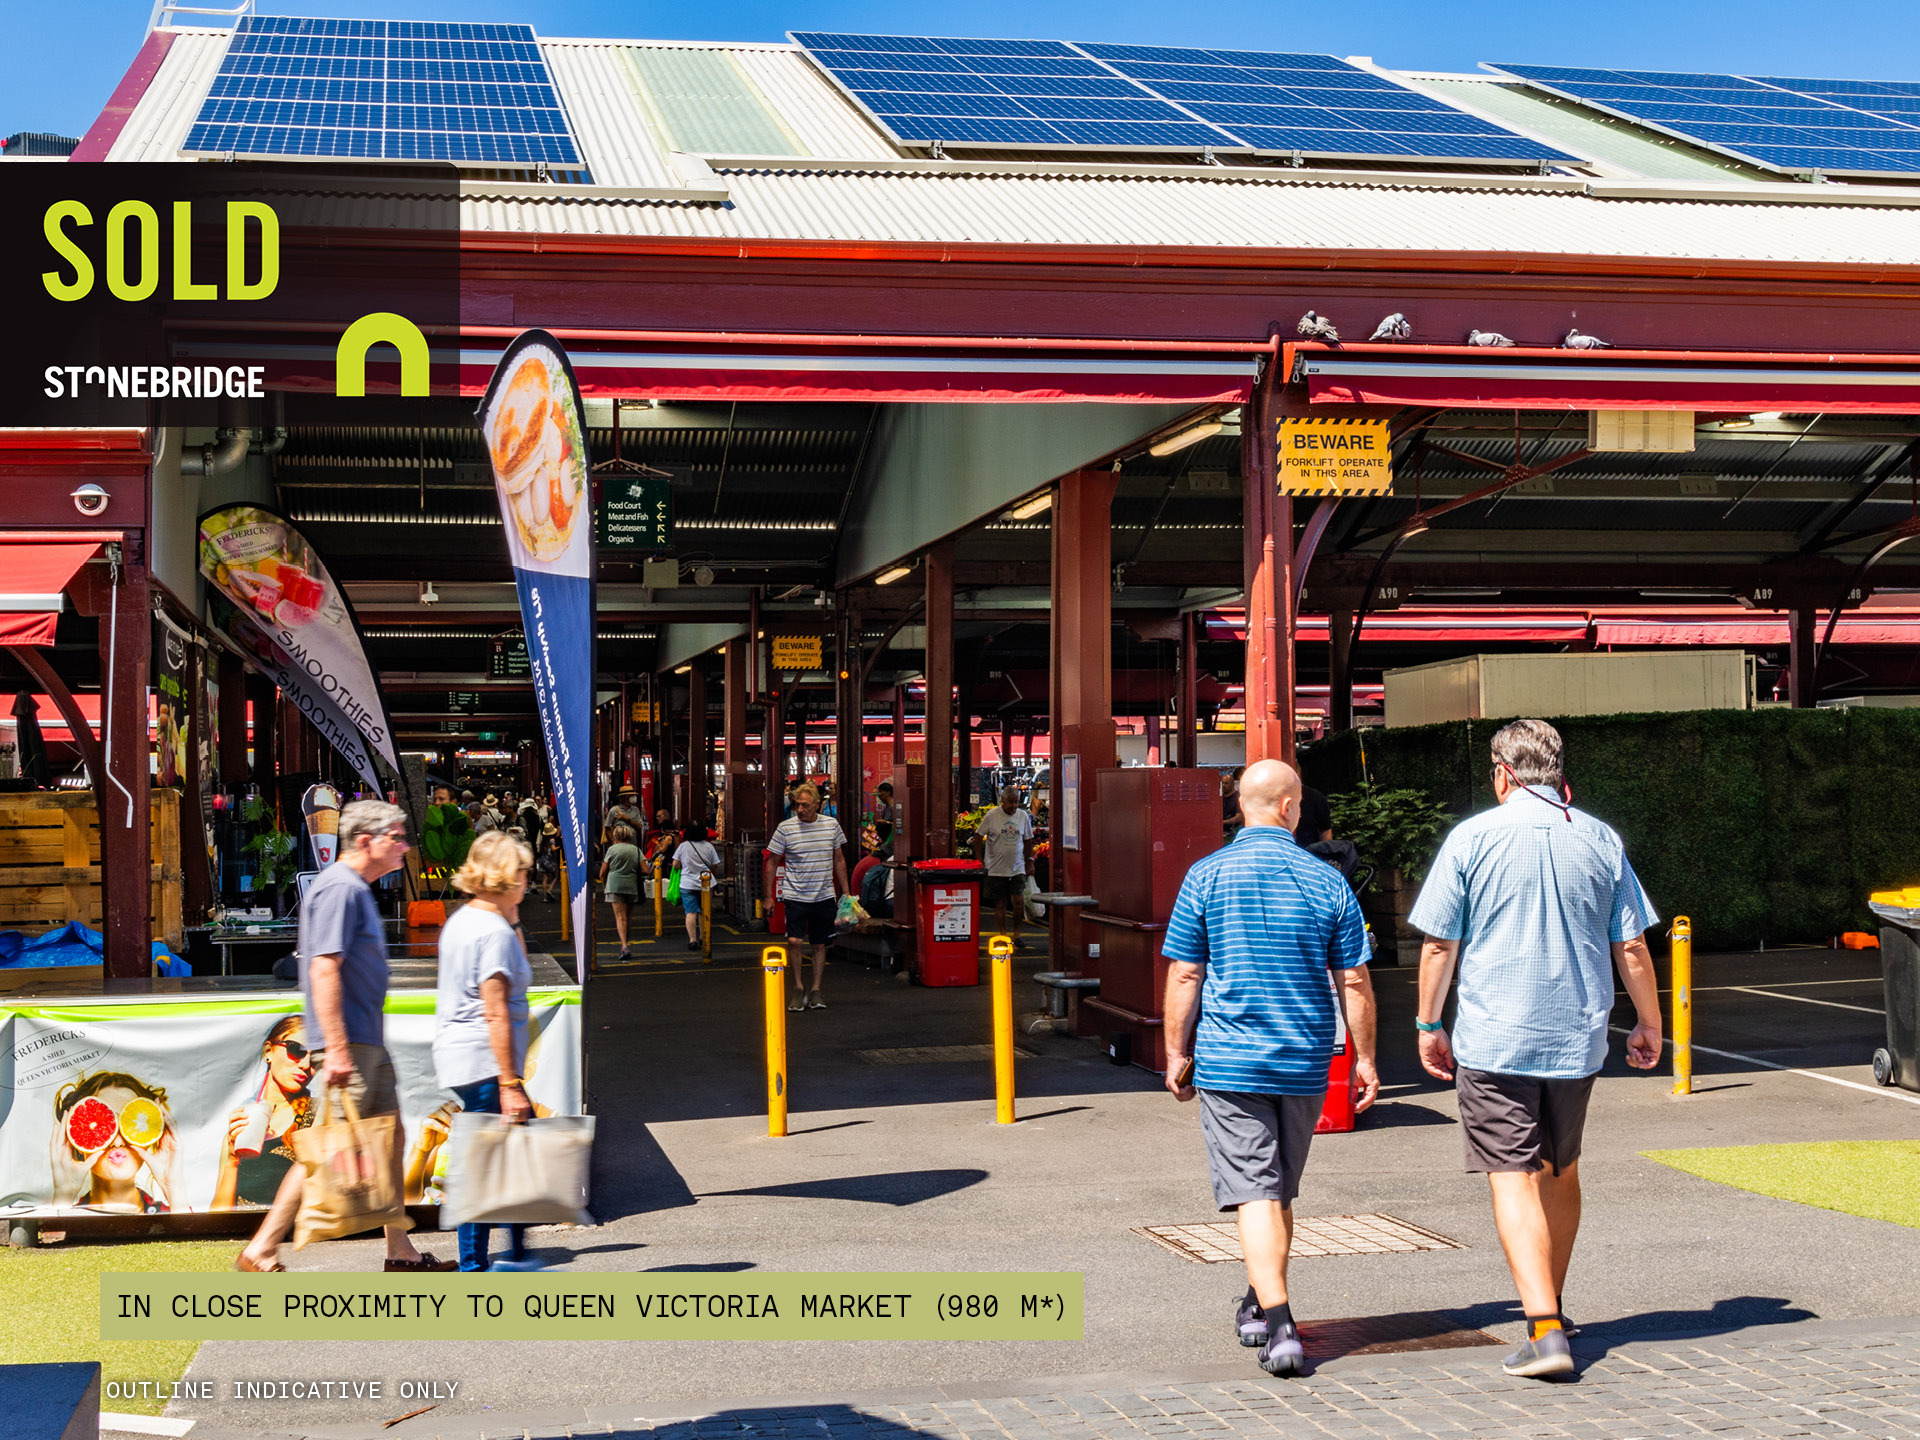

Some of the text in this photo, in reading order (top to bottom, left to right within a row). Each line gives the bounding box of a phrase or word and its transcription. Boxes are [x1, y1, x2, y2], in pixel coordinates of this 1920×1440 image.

[1294, 435, 1375, 450] BEWARE
[1286, 458, 1384, 467] FORKLIFT OPERATE
[1300, 469, 1370, 477] IN THIS AREA
[607, 501, 642, 510] Food Court
[607, 512, 649, 521] Meat and Fish
[607, 524, 647, 532] Delicatessens
[216, 527, 271, 546] FREDERICKS
[607, 535, 635, 545] Organics
[1378, 587, 1398, 599] A90
[1753, 588, 1773, 600] A89
[277, 630, 385, 743] SMOOTHIES
[276, 670, 366, 771] SMOOTHIES
[12, 1030, 86, 1062] FREDERICKS
[47, 1049, 66, 1060] SHED
[17, 1050, 101, 1086] QUEEN VICTORIA MARKET
